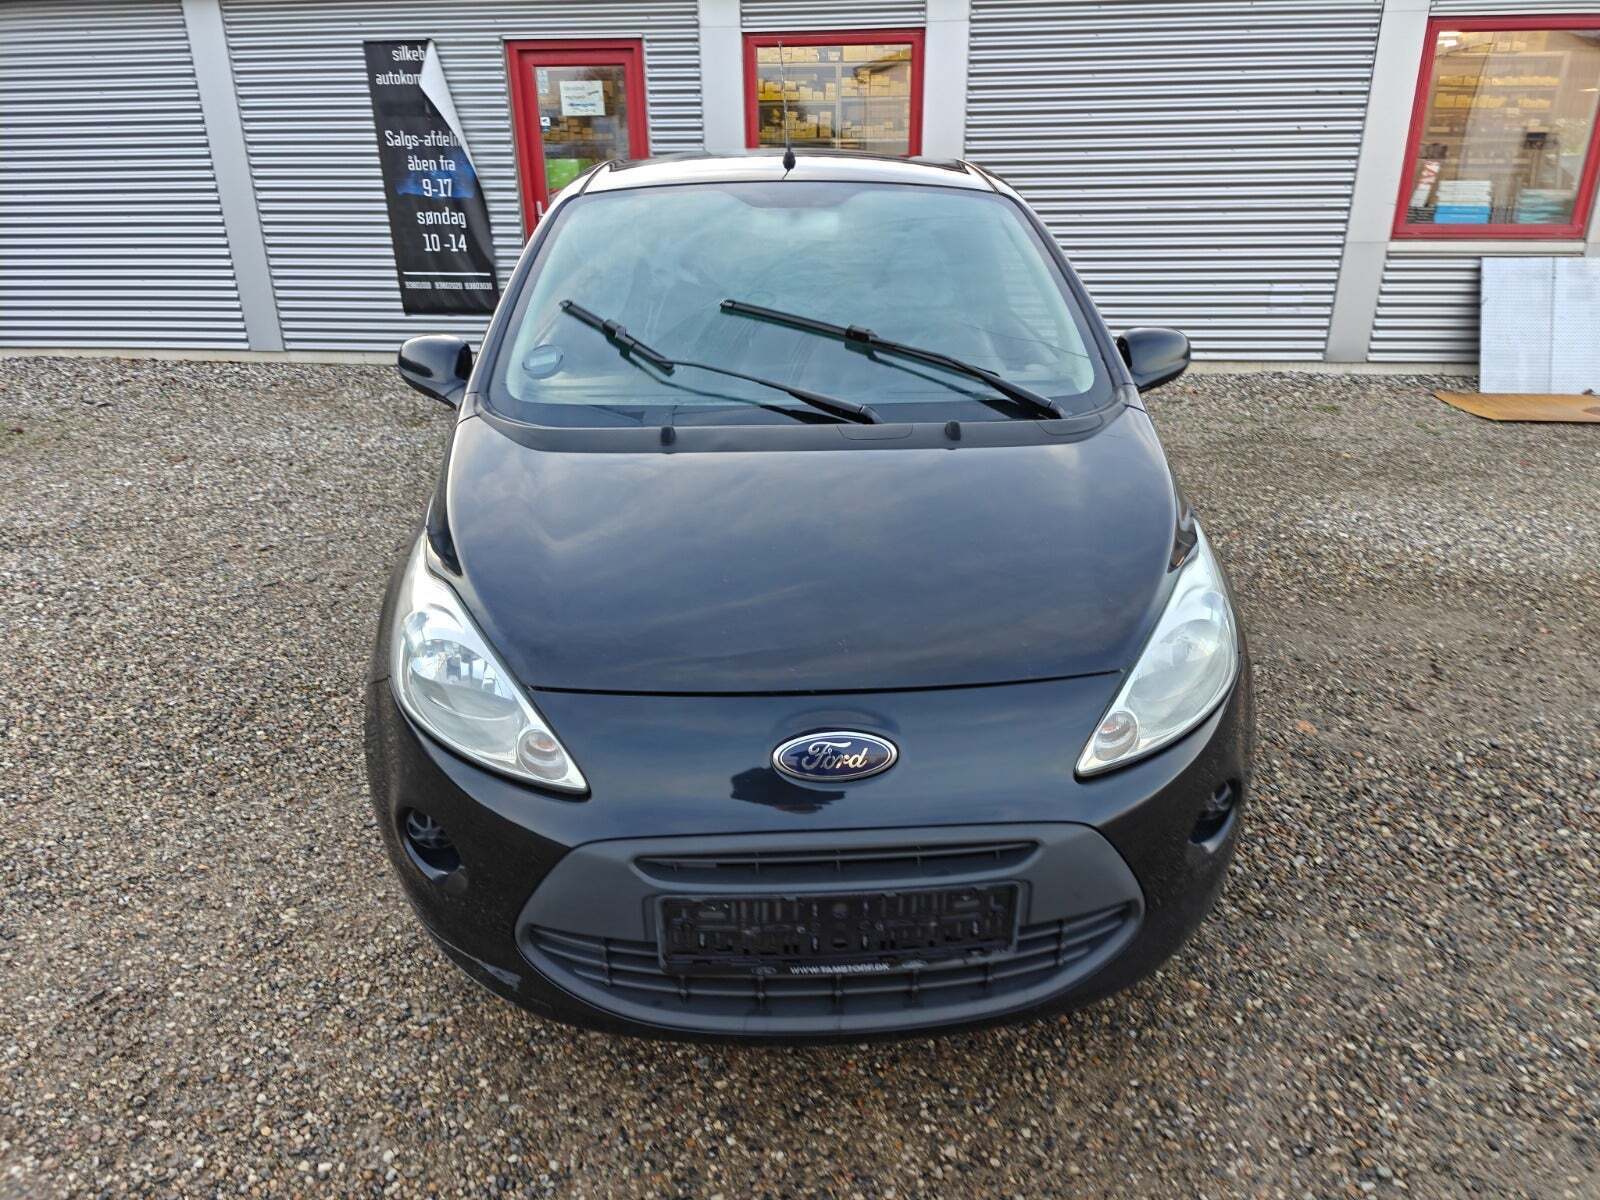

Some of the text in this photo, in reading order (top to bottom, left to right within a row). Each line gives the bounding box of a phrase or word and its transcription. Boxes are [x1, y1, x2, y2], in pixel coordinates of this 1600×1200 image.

[407, 154, 456, 171] åben fra
[421, 178, 452, 197] 9-17
[416, 206, 467, 228] søndag
[422, 233, 441, 252] 10
[801, 741, 868, 770] Ford
